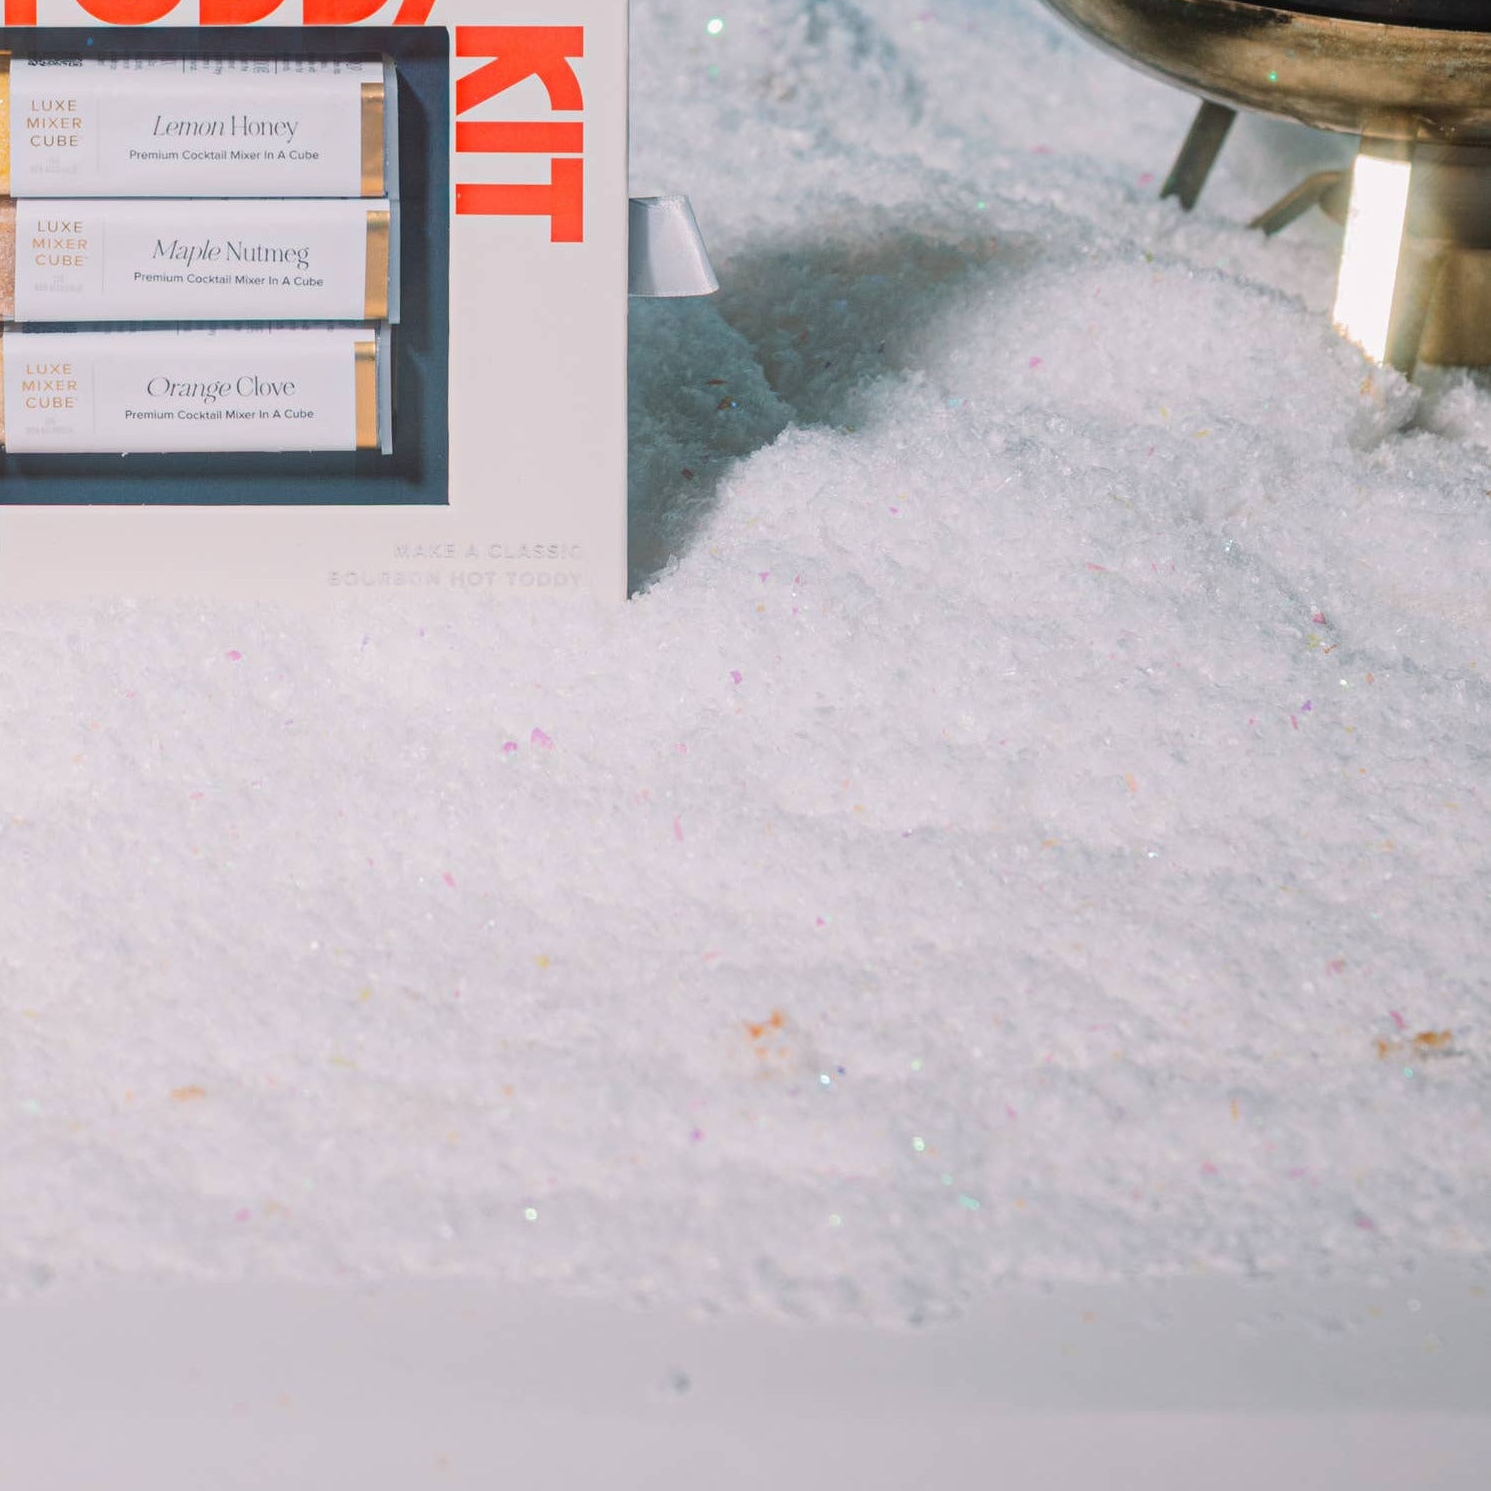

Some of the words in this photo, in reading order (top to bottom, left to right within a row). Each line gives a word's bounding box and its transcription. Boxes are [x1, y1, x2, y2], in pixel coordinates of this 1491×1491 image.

[32, 100, 76, 112] LUXE
[27, 117, 81, 129] MIXER
[153, 115, 224, 136] Lemon
[232, 115, 298, 143] Honey
[455, 25, 585, 243] KIT
[30, 135, 77, 147] CUBE
[130, 150, 178, 160] Premium
[182, 150, 227, 160] Cocktail
[231, 151, 261, 160] Mixer
[264, 151, 274, 159] In
[277, 150, 286, 159] A
[289, 150, 319, 160] Cube
[37, 221, 82, 234] LUXE
[32, 238, 87, 249] MIXER
[36, 254, 82, 266] CUBE
[153, 239, 221, 267] Maple
[226, 241, 309, 269] Nutmeg
[134, 272, 183, 282] Premium
[187, 274, 231, 284] Cocktail
[235, 275, 265, 285] Mixer
[269, 276, 278, 285] In
[282, 276, 291, 285] A
[294, 277, 323, 287] Cube
[27, 364, 70, 374] LUXE
[22, 380, 77, 391] MIXER
[147, 377, 231, 404] Orange
[237, 375, 295, 396] Clove
[26, 397, 73, 408] CUBE
[125, 410, 174, 419] Premium
[178, 410, 222, 420] Cocktail
[226, 410, 255, 419] Mixer
[259, 410, 269, 418] In
[272, 410, 281, 418] A
[284, 409, 314, 419] Cube
[394, 544, 454, 559] MAKE
[488, 543, 583, 559] CLASSIC
[450, 571, 497, 587] HOT
[507, 571, 582, 587] TODDY
